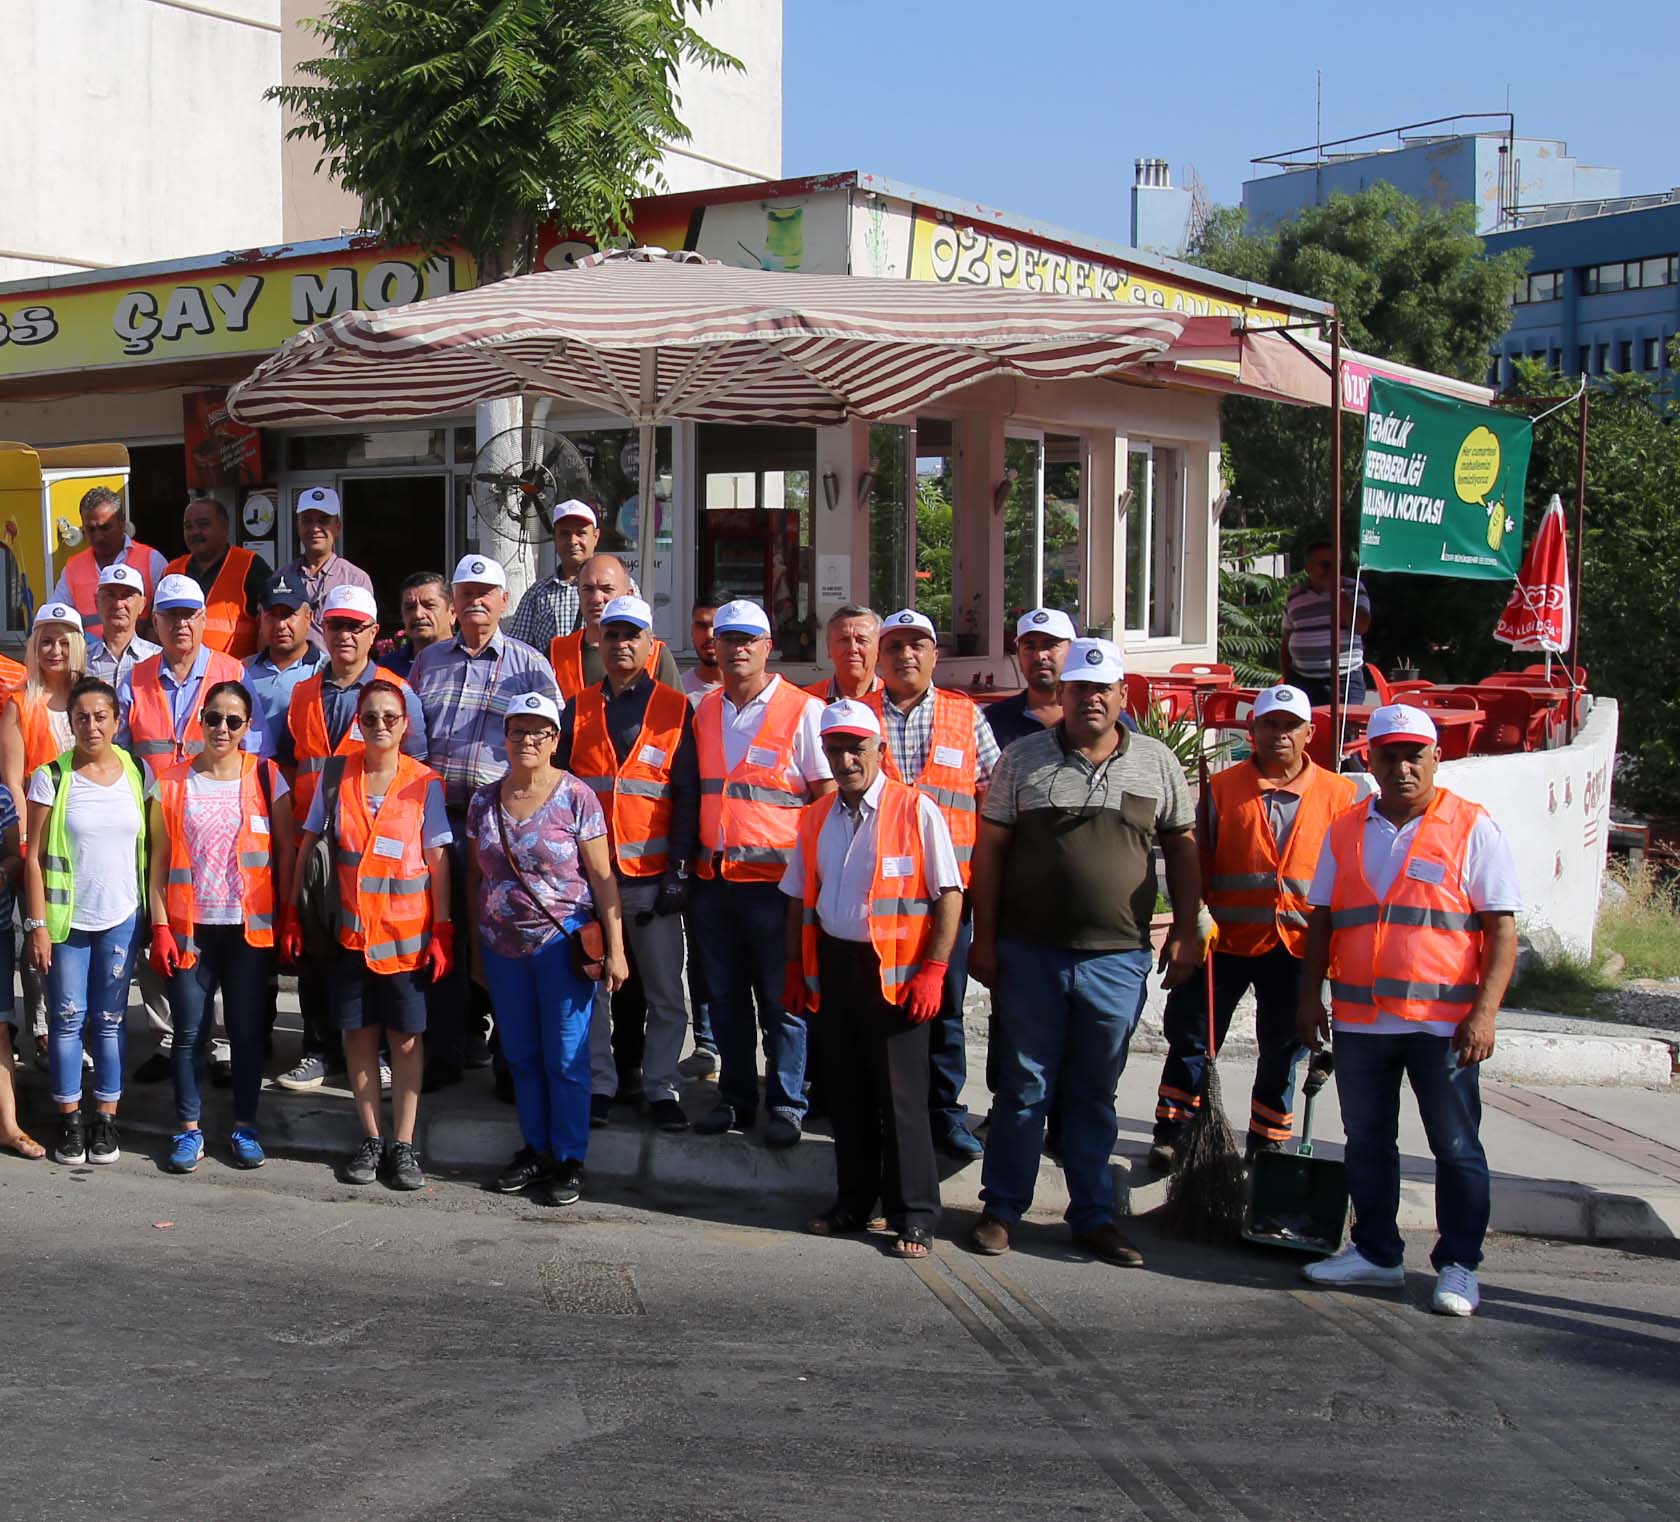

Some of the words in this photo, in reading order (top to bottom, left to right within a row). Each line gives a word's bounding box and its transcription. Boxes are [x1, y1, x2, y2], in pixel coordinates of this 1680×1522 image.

[113, 275, 264, 355] ÇAY
[1368, 410, 1415, 449] TEMİZLİK
[1395, 492, 1446, 525] NOKTASI
